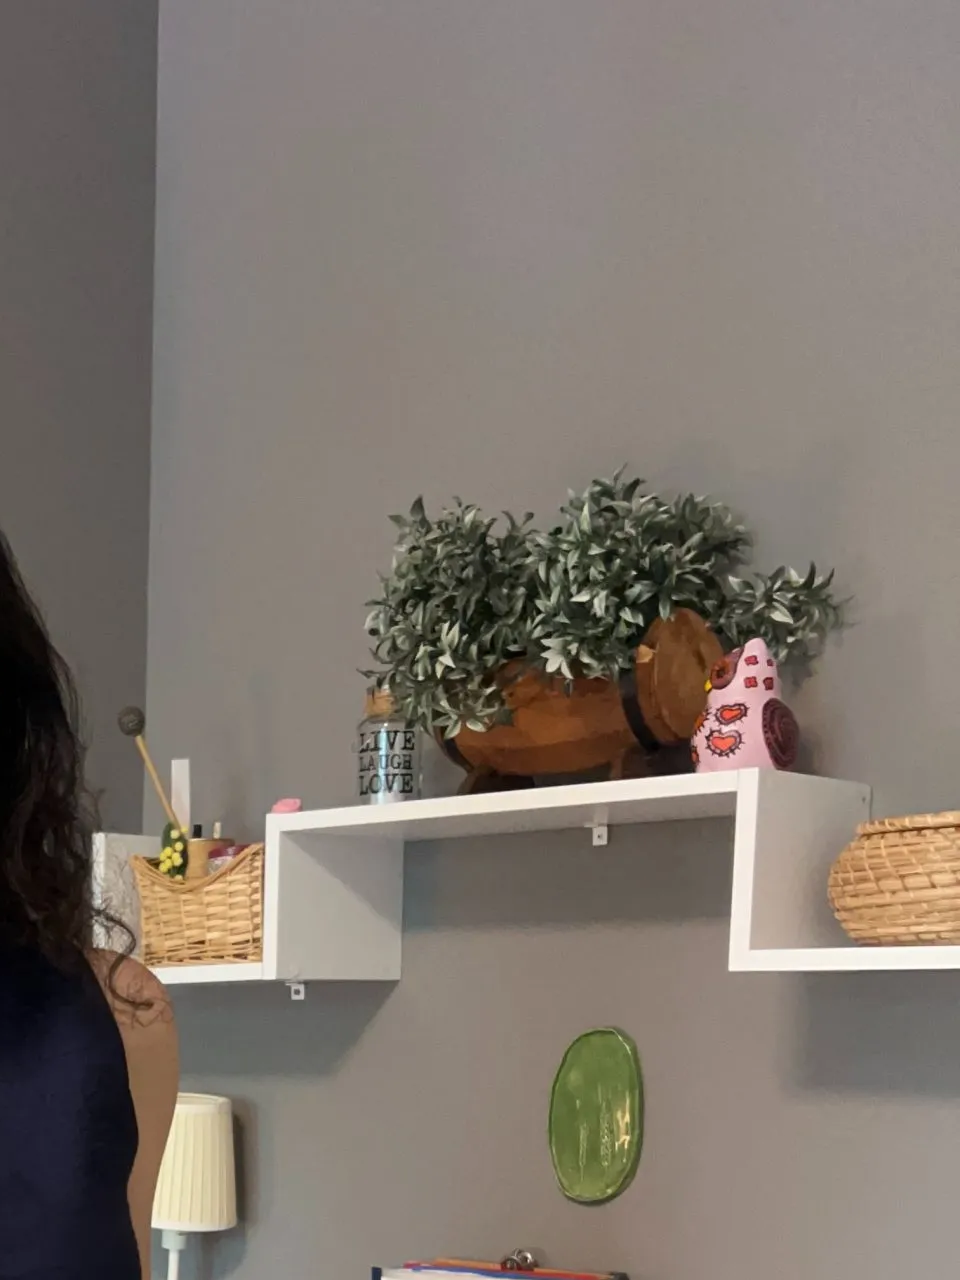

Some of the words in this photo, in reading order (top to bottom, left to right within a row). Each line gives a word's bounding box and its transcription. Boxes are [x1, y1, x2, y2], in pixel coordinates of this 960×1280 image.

[359, 730, 415, 754] LIVE
[359, 753, 413, 773] LAUGH
[358, 773, 414, 797] LOVE
